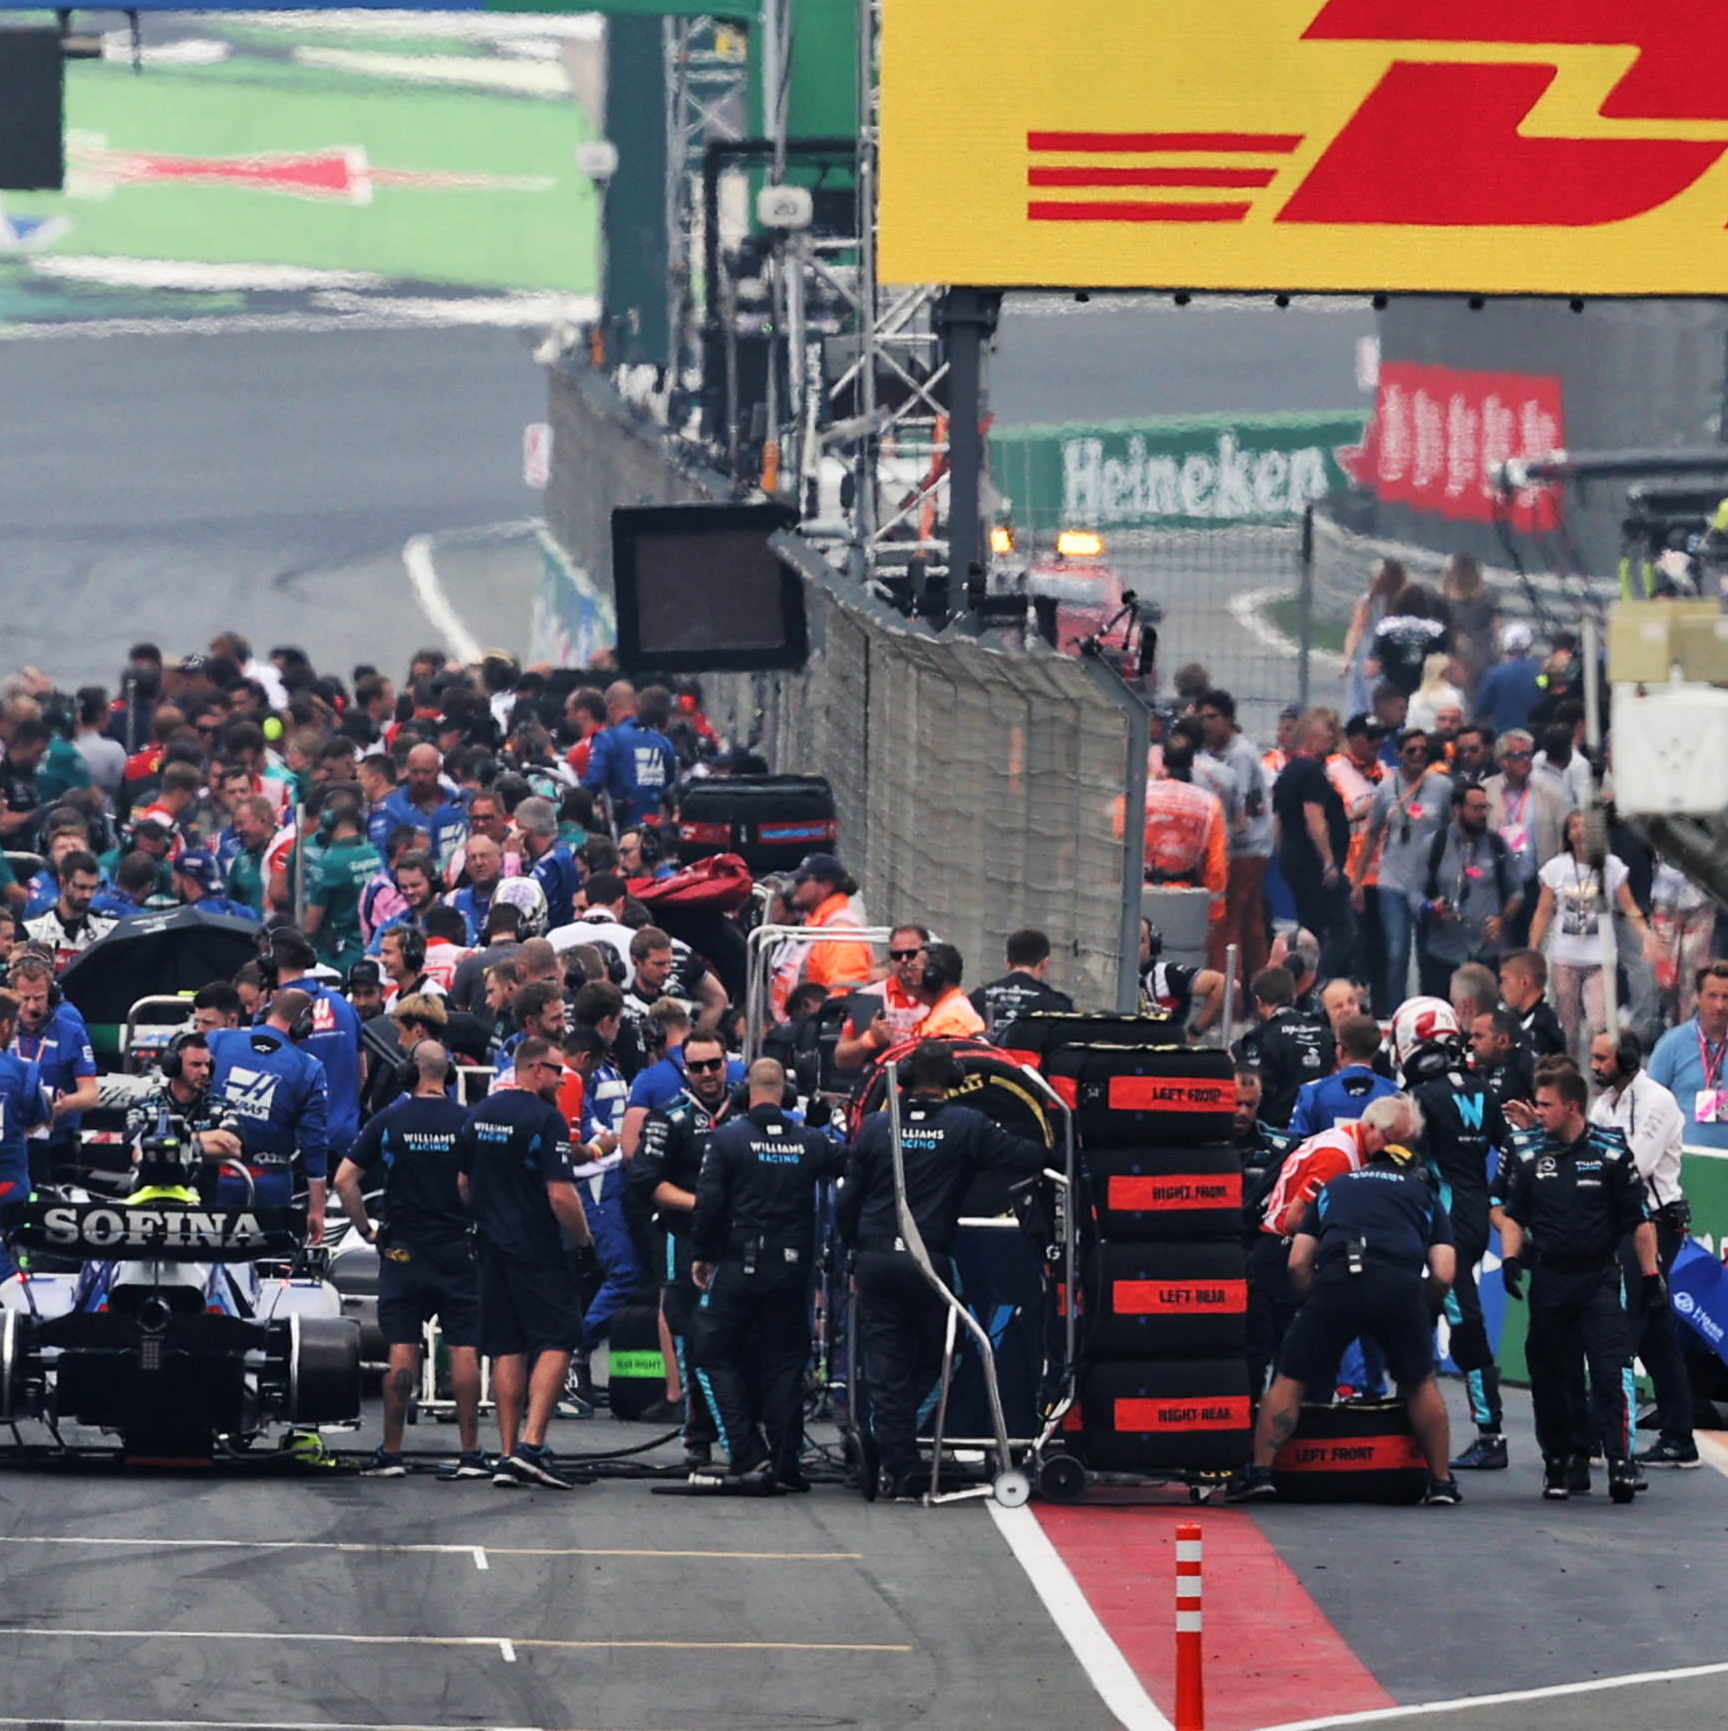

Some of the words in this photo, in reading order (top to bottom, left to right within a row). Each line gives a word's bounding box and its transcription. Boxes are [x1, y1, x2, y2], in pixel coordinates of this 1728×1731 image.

[1062, 428, 1329, 526] Heineken
[1152, 1087, 1184, 1101] LEFT
[474, 1122, 513, 1135] WILLIAMS
[403, 1132, 456, 1145] WILLIAMS
[409, 1142, 450, 1153] RACING
[749, 1140, 805, 1154] WILLIAMS
[758, 1151, 800, 1164] RACING
[1152, 1186, 1192, 1200] RIGHT
[43, 1207, 269, 1247] SOFINA
[1159, 1288, 1192, 1304] LEFT
[1195, 1288, 1226, 1303] REAR
[1157, 1407, 1199, 1422] RIGHT
[1295, 1448, 1327, 1463] LEFT
[1331, 1445, 1375, 1461] FRONT
